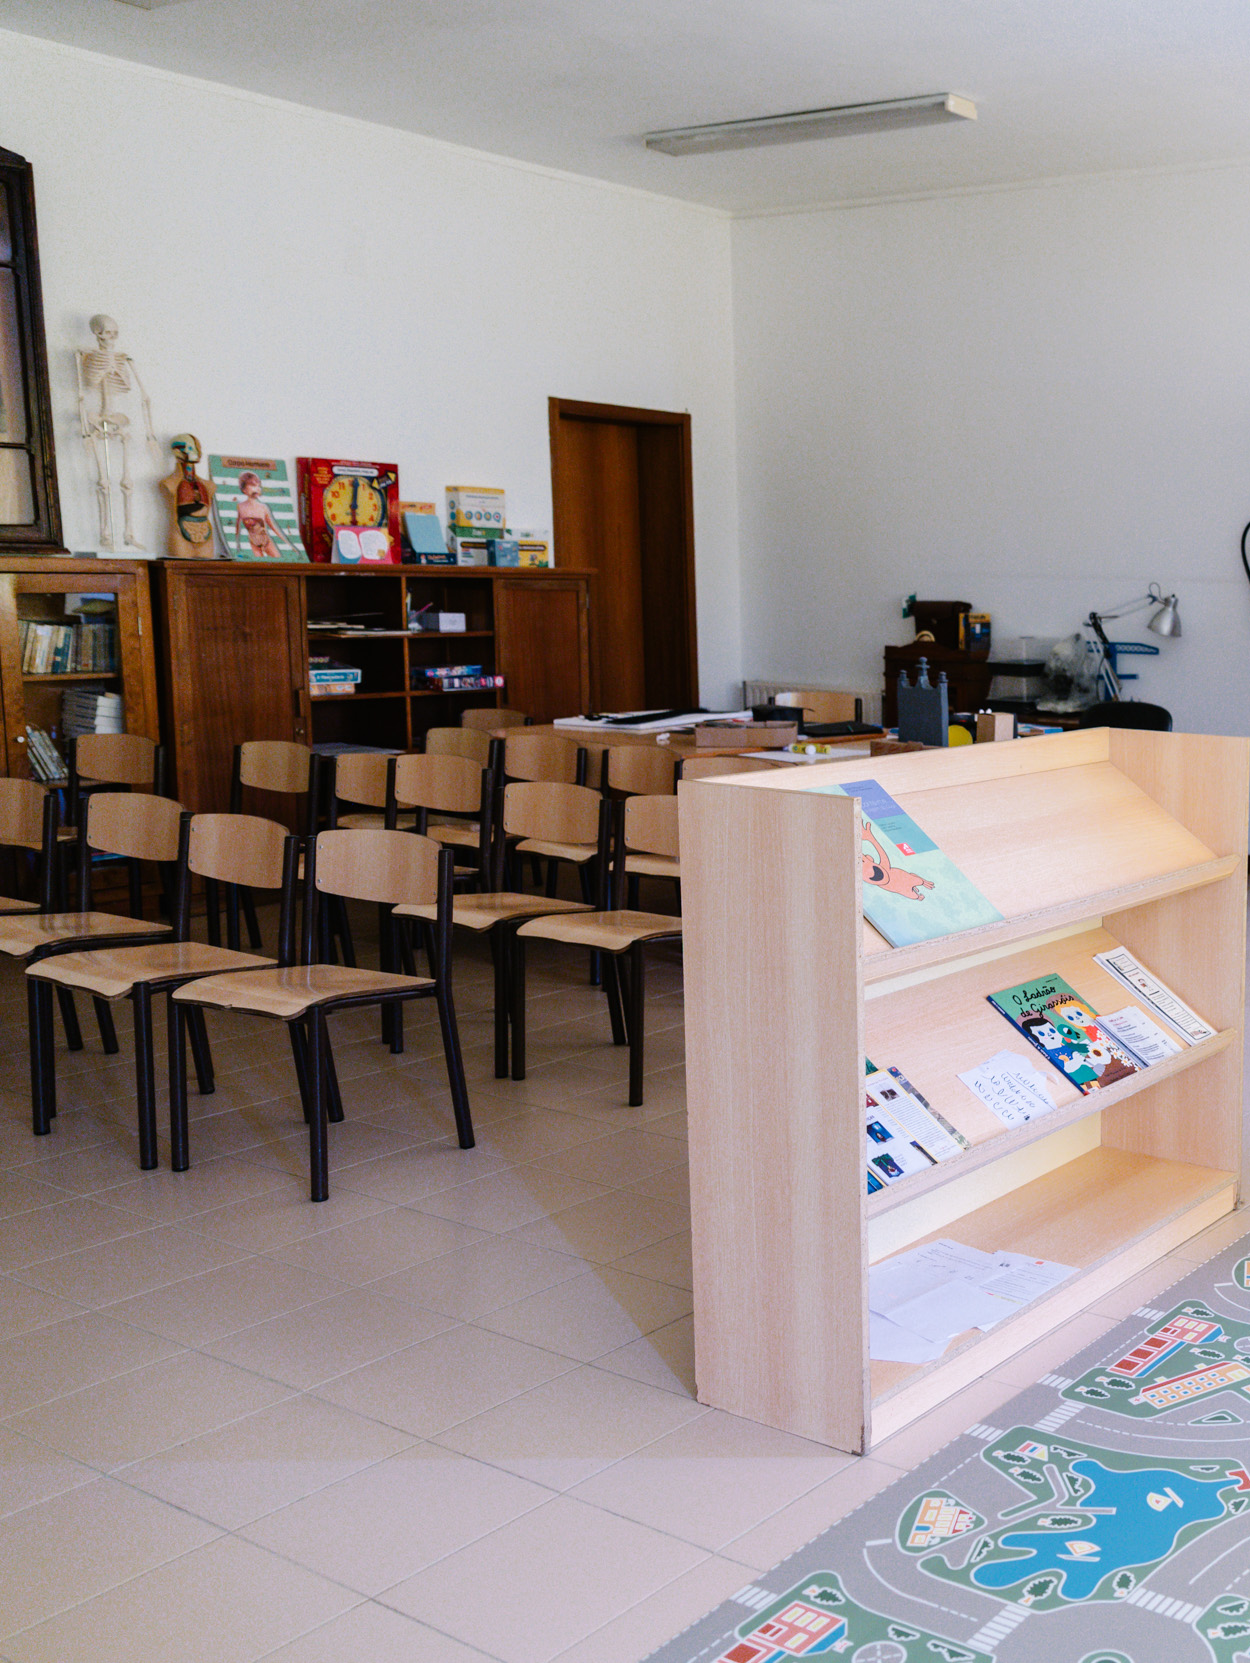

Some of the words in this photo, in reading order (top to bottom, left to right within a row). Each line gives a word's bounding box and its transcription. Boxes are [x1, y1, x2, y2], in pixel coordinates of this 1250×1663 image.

[1012, 995, 1022, 1005] O
[1023, 986, 1056, 1002] Ladrão
[1020, 1008, 1033, 1018] de
[1030, 994, 1074, 1019] Girassóis
